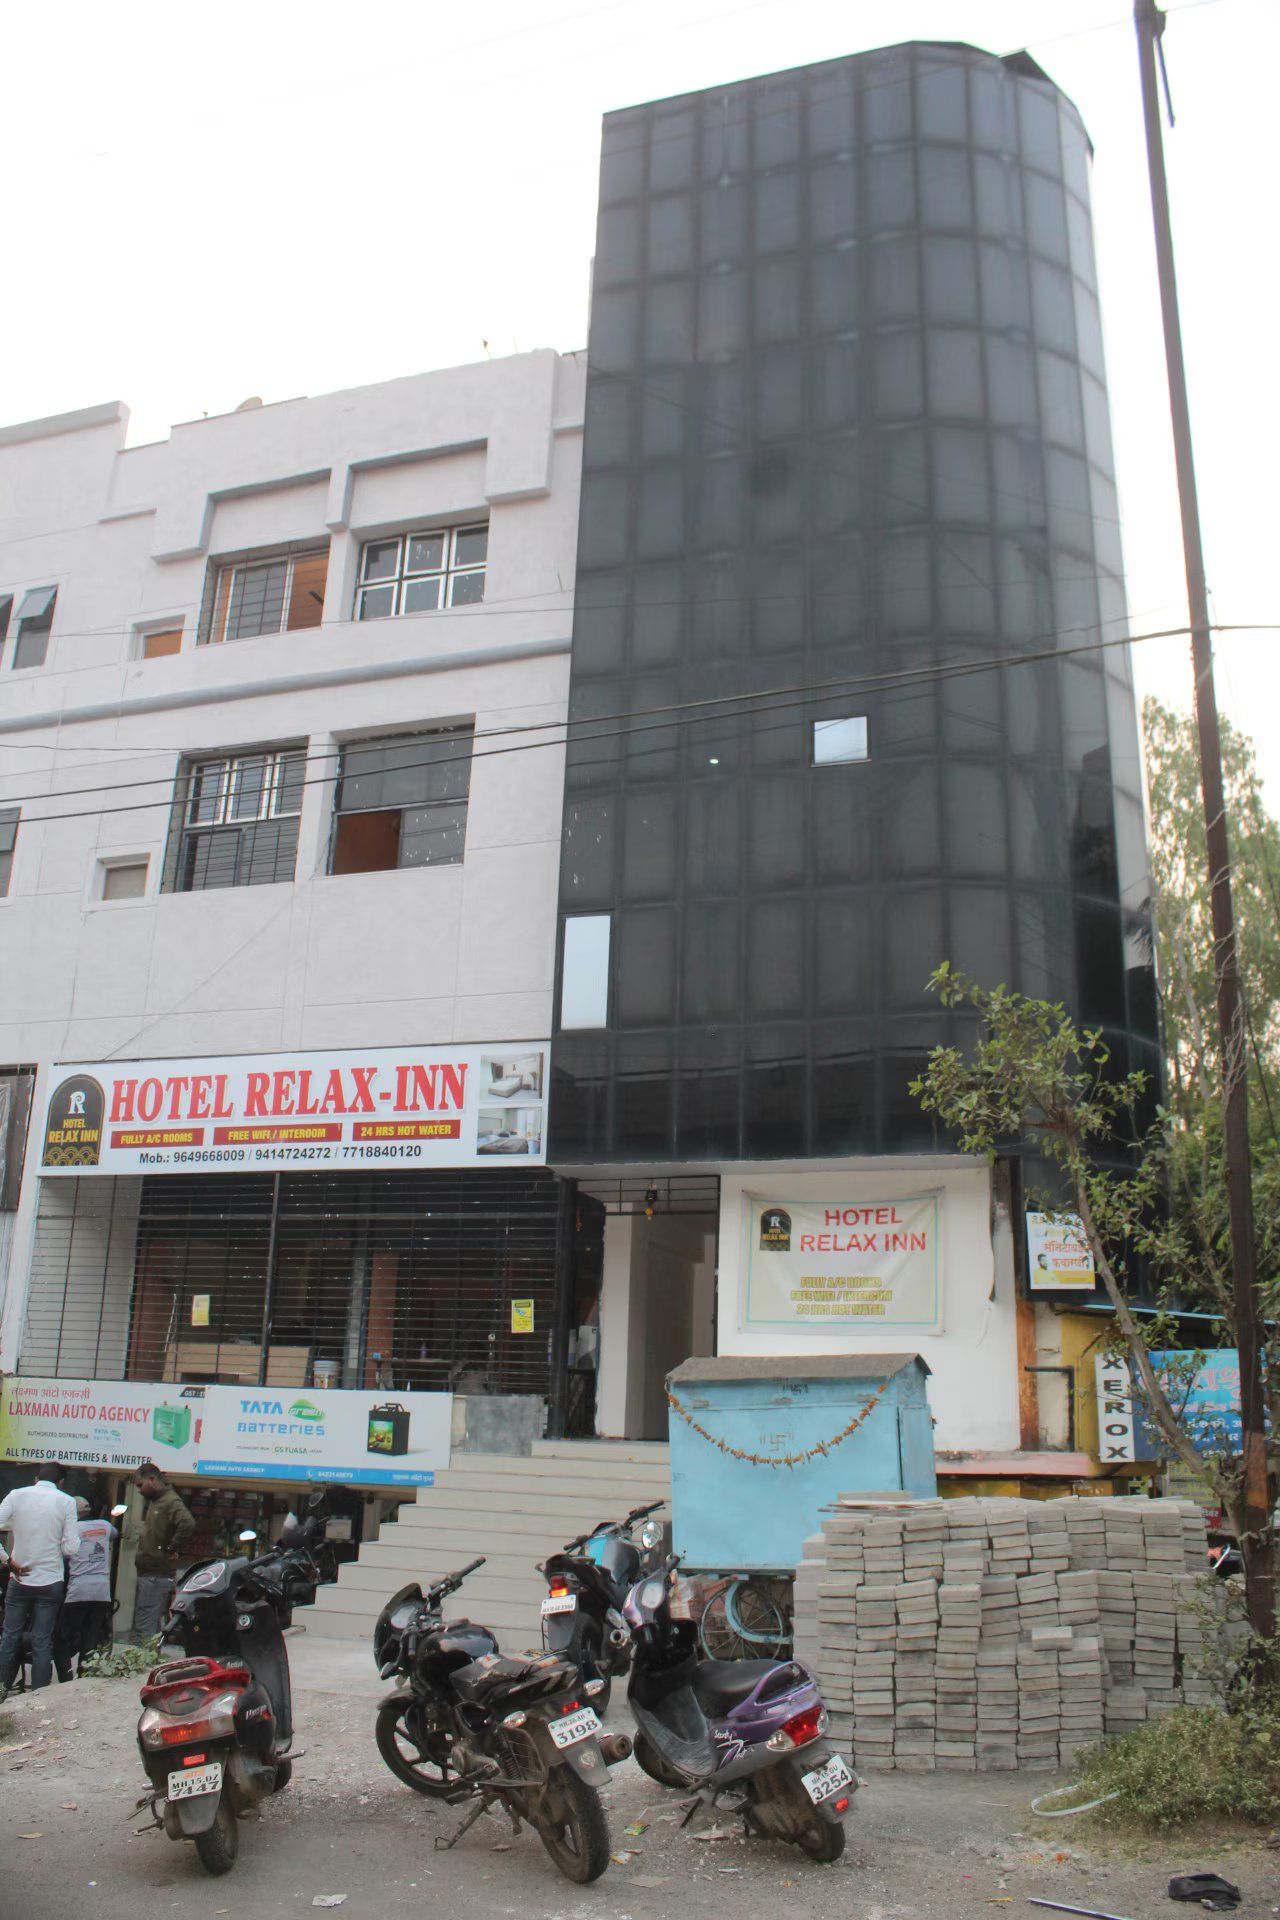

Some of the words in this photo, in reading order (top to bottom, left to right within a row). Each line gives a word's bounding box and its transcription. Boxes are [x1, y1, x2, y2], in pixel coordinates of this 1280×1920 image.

[108, 1074, 233, 1122] HOTEL
[243, 1063, 469, 1117] RELAX-INN
[68, 1091, 86, 1114] R
[63, 1118, 87, 1129] HOTEL
[361, 1126, 373, 1137] 24
[376, 1125, 394, 1136] HRS
[398, 1125, 416, 1135] HOT
[419, 1124, 452, 1135] WATER
[49, 1129, 78, 1143] RELAX
[80, 1129, 99, 1142] INN
[120, 1134, 145, 1145] FULLY
[146, 1133, 161, 1144] A/C
[162, 1132, 193, 1143] ROOMS
[228, 1130, 249, 1140] FREE
[252, 1129, 270, 1139] WIFI
[140, 1152, 170, 1164] Mob.:
[173, 1148, 245, 1163] 9649668009
[255, 1147, 331, 1160] 9414724272
[342, 1145, 422, 1158] 7718840120
[824, 1207, 904, 1227] HOTEL
[800, 1233, 877, 1252] RELAX
[885, 1232, 927, 1252] INN
[9, 1401, 59, 1418] LAXMAN
[62, 1404, 96, 1420] AUTO
[99, 1406, 150, 1423] AGENCY
[240, 1400, 283, 1415] TATA
[5, 1447, 20, 1457] ALL
[21, 1448, 45, 1459] TYPES
[46, 1449, 56, 1460] OF
[58, 1451, 100, 1462] BATTERIES
[102, 1454, 108, 1463] &
[557, 1720, 598, 1744] 3198
[172, 1781, 220, 1797] 7447
[813, 1770, 849, 1800] 3254
